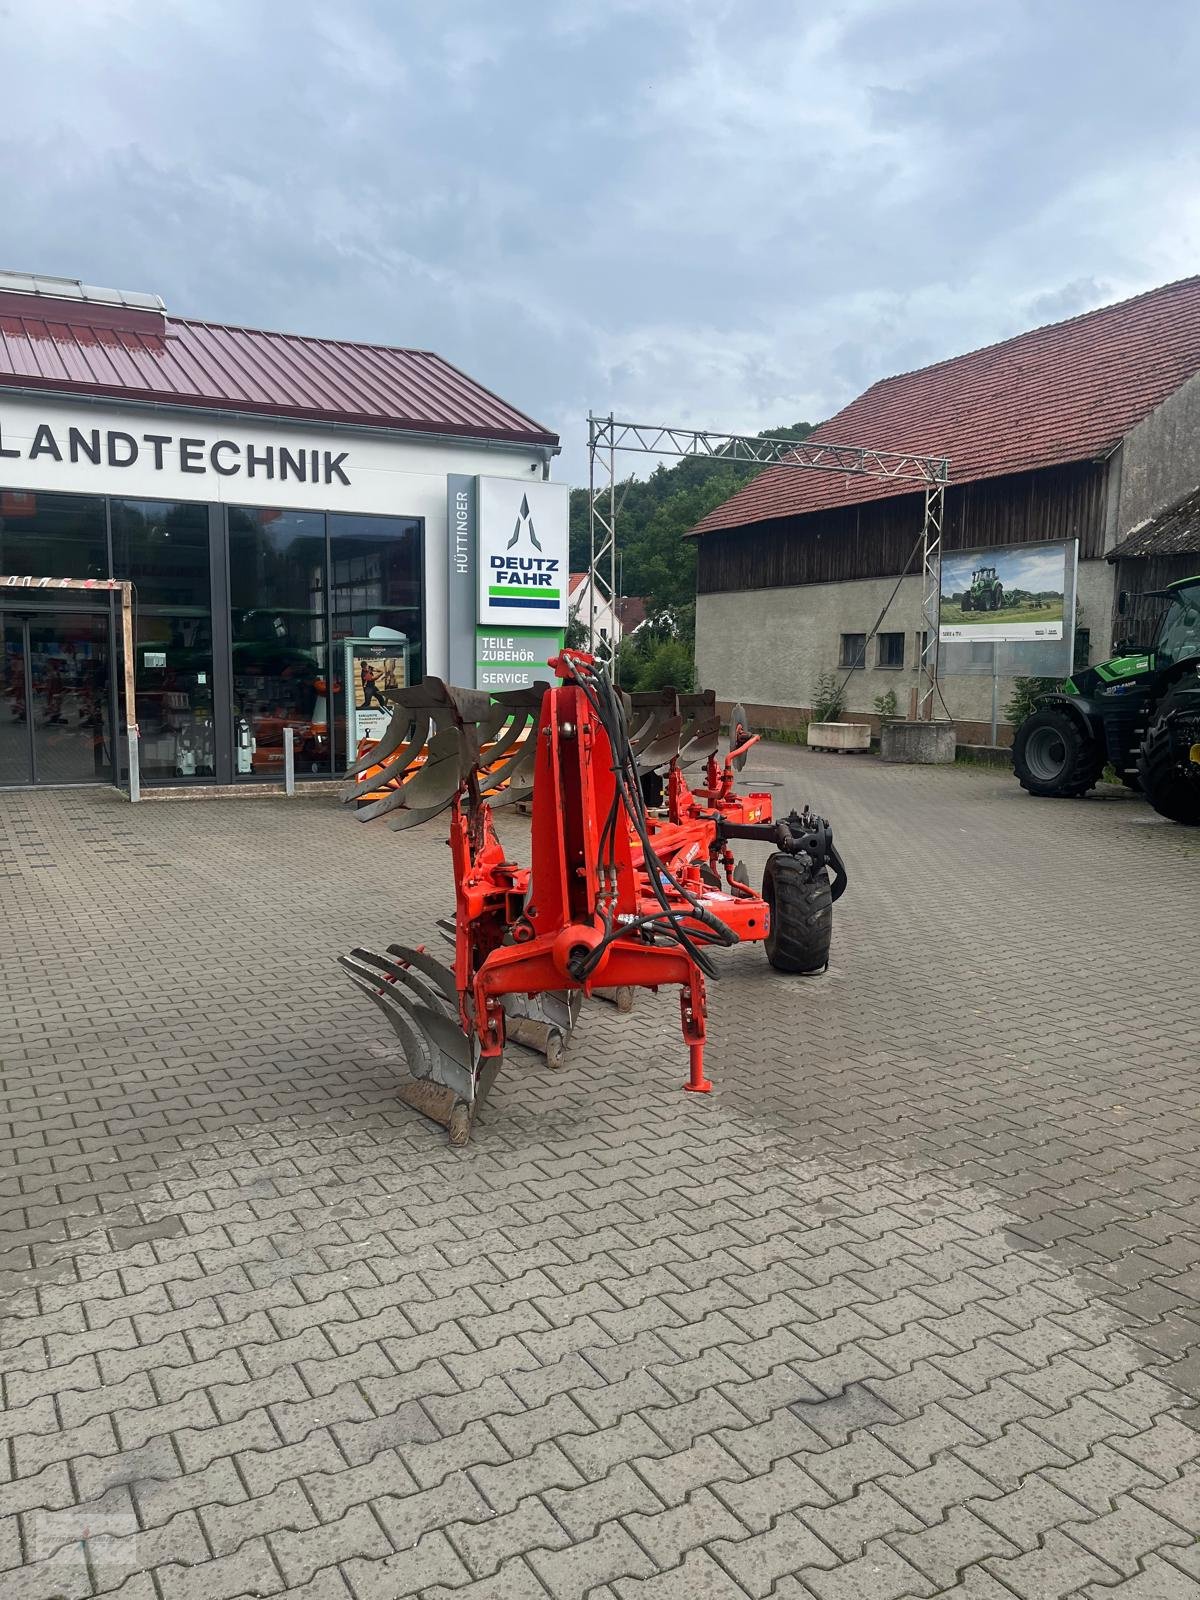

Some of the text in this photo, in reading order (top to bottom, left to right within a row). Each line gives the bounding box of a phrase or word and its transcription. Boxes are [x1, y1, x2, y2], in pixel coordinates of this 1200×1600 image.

[0, 421, 351, 485] LANDTECHNIK
[453, 492, 468, 573] HÜTTINGER
[490, 555, 559, 571] DEUTZ
[496, 571, 552, 586] FAHR
[482, 638, 514, 649] TEILE
[482, 649, 534, 662] ZUBEHÖR
[482, 673, 529, 684] SERVICE
